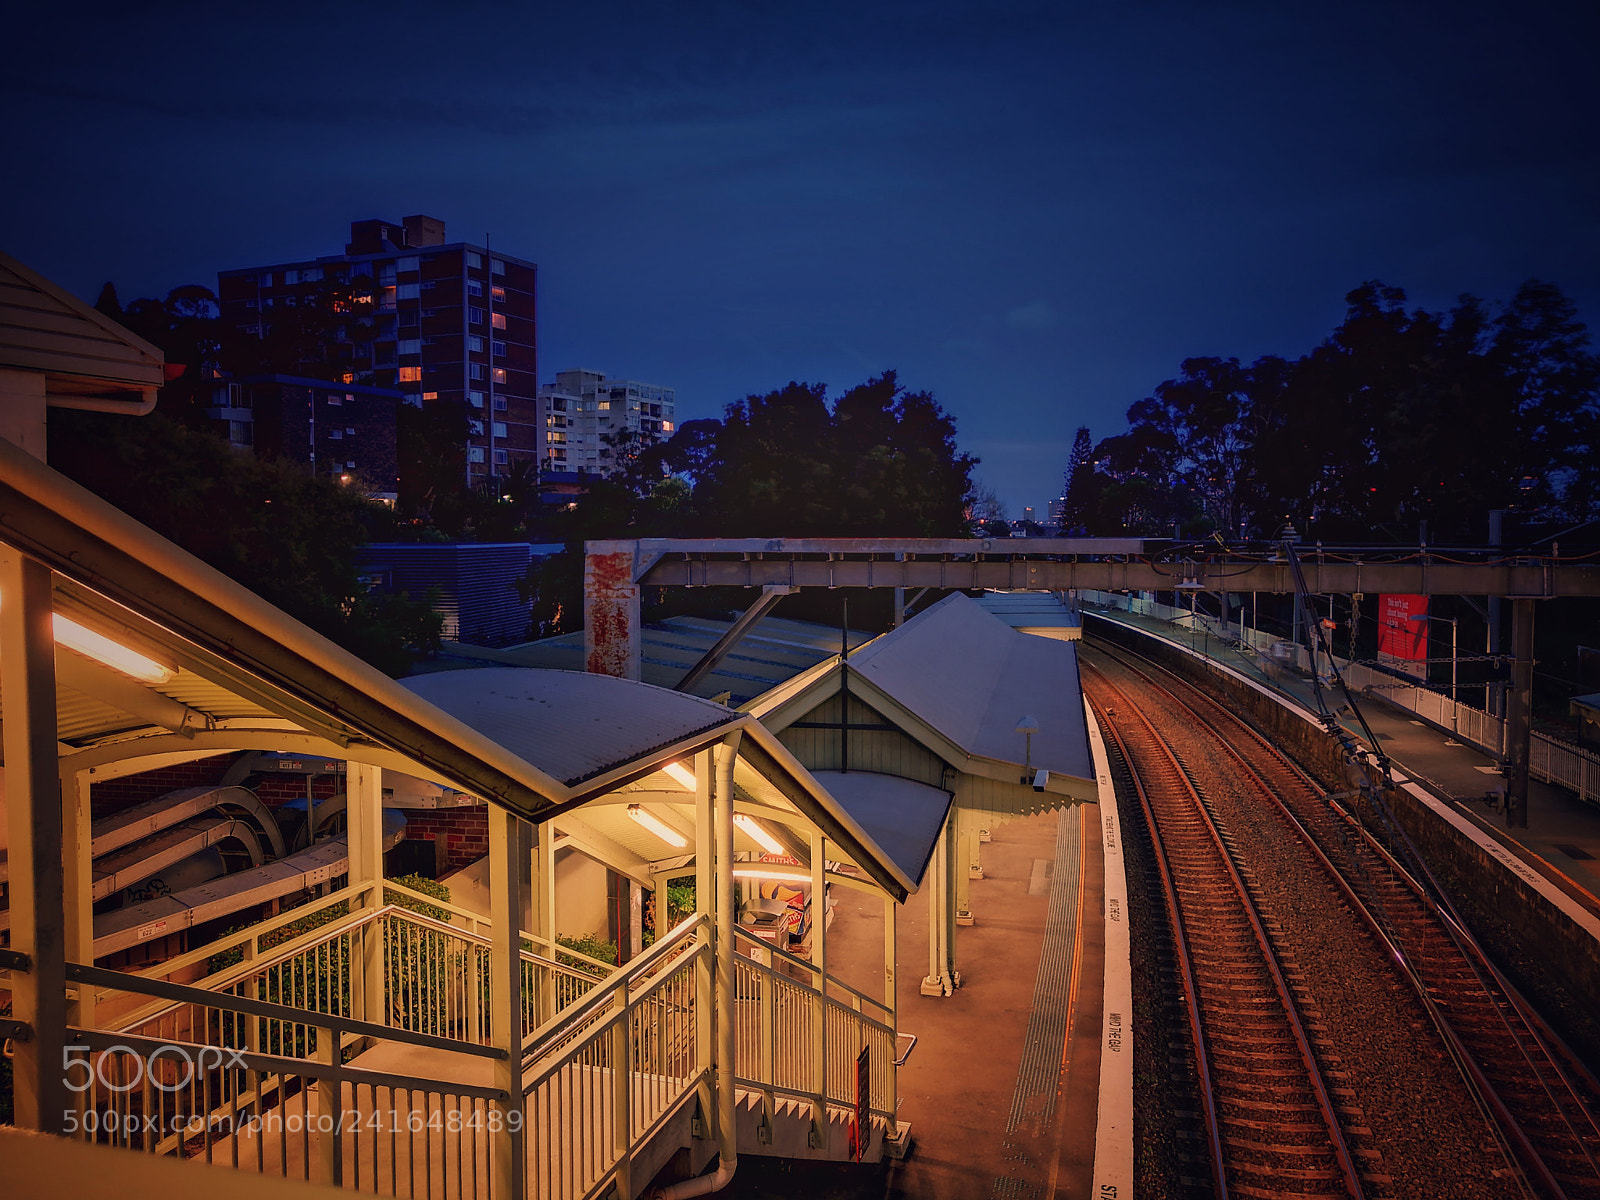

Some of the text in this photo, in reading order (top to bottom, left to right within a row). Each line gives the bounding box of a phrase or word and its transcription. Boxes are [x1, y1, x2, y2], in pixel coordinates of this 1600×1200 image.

[1108, 1013, 1122, 1053] MIND THE GAP
